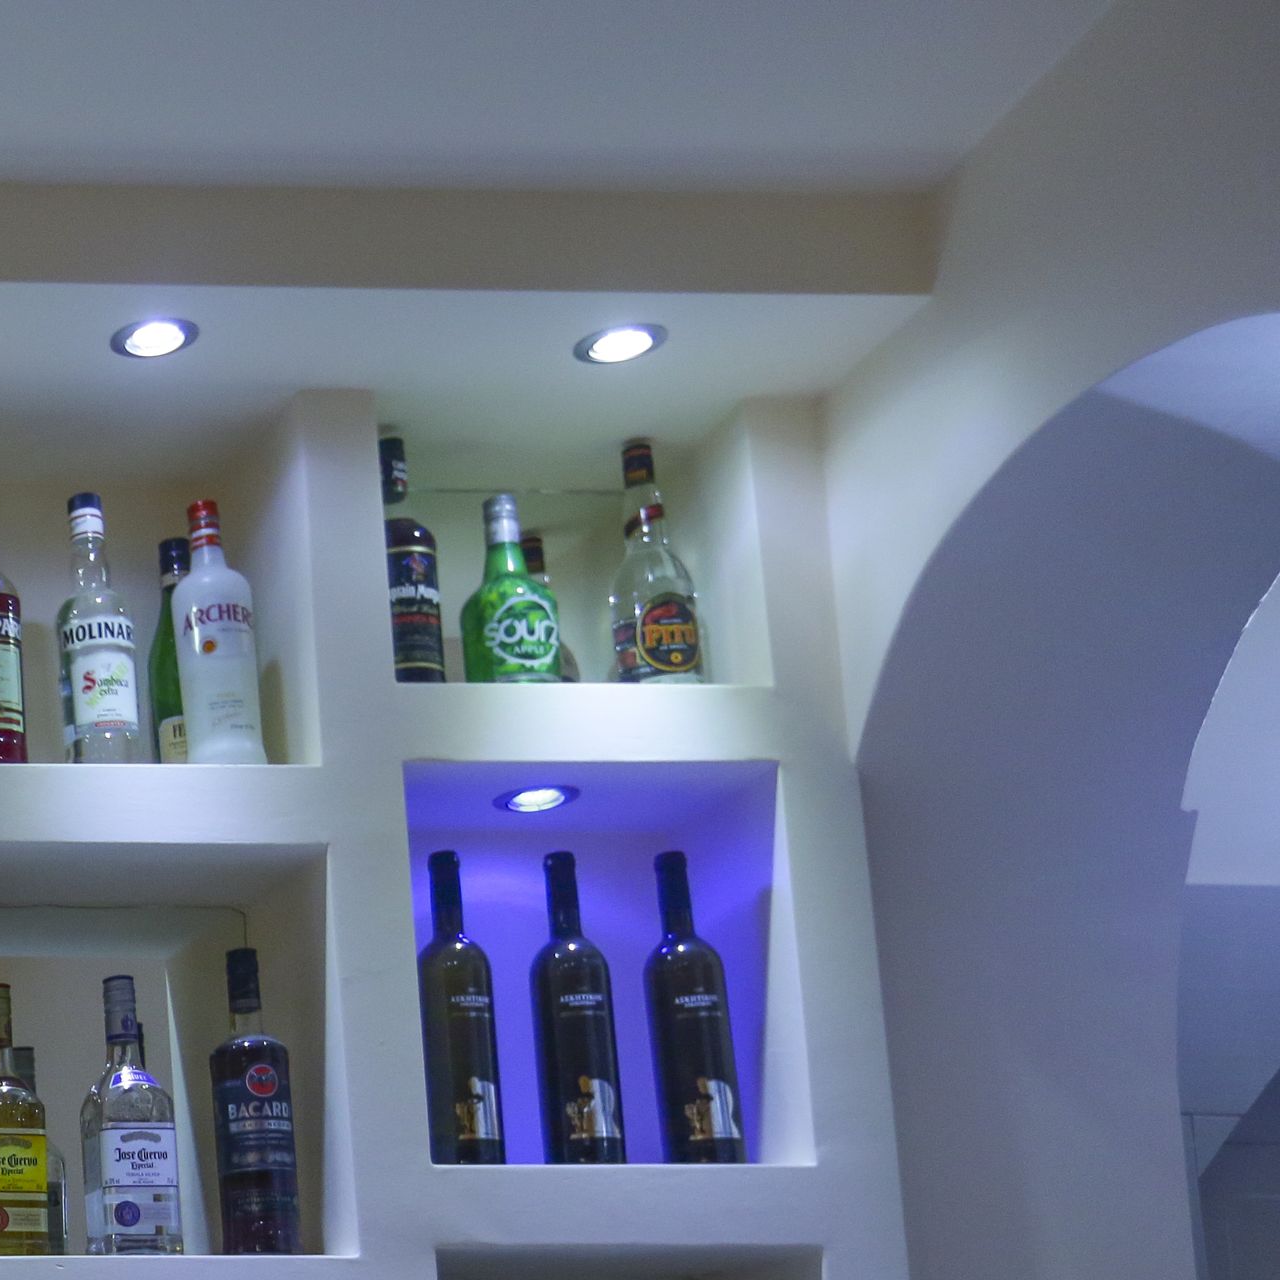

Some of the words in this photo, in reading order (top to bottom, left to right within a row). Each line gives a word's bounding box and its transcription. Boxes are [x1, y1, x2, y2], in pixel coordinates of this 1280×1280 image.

[63, 622, 134, 644] MOLINAR
[82, 670, 129, 694] Sambuca
[228, 1101, 289, 1120] BACARD
[7, 1153, 38, 1168] Cuervo
[114, 1147, 136, 1162] Jose
[138, 1147, 168, 1163] Cuervo
[130, 1161, 154, 1171] Especial
